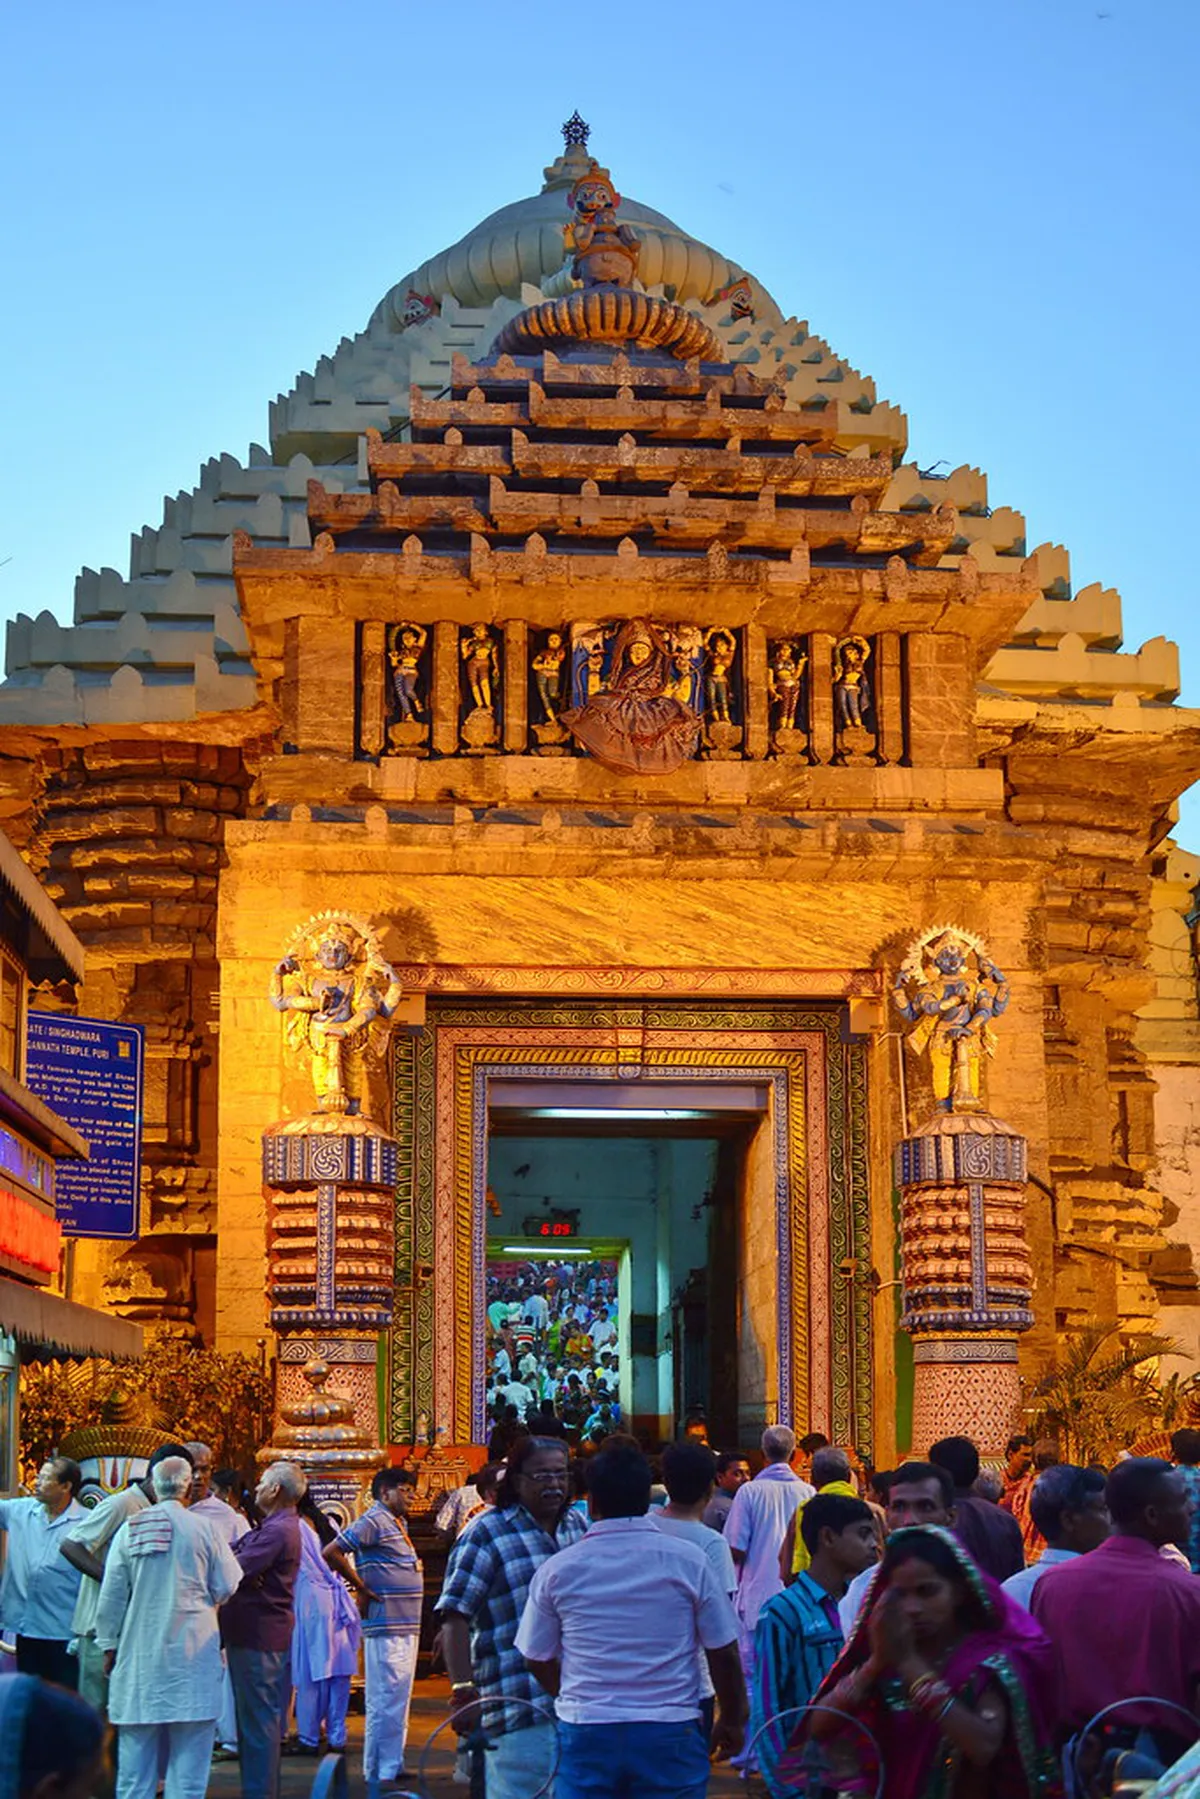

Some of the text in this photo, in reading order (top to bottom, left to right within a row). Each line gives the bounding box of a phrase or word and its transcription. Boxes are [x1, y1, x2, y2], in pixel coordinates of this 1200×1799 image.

[92, 1048, 110, 1060] PURI
[47, 1065, 75, 1074] famous
[77, 1069, 101, 1078] temple
[115, 1073, 135, 1082] Shree
[52, 1085, 62, 1093] by
[64, 1087, 81, 1096] King
[80, 1117, 95, 1125] four
[123, 1121, 135, 1129] the
[112, 1160, 133, 1168] Shree
[90, 1187, 99, 1195] go
